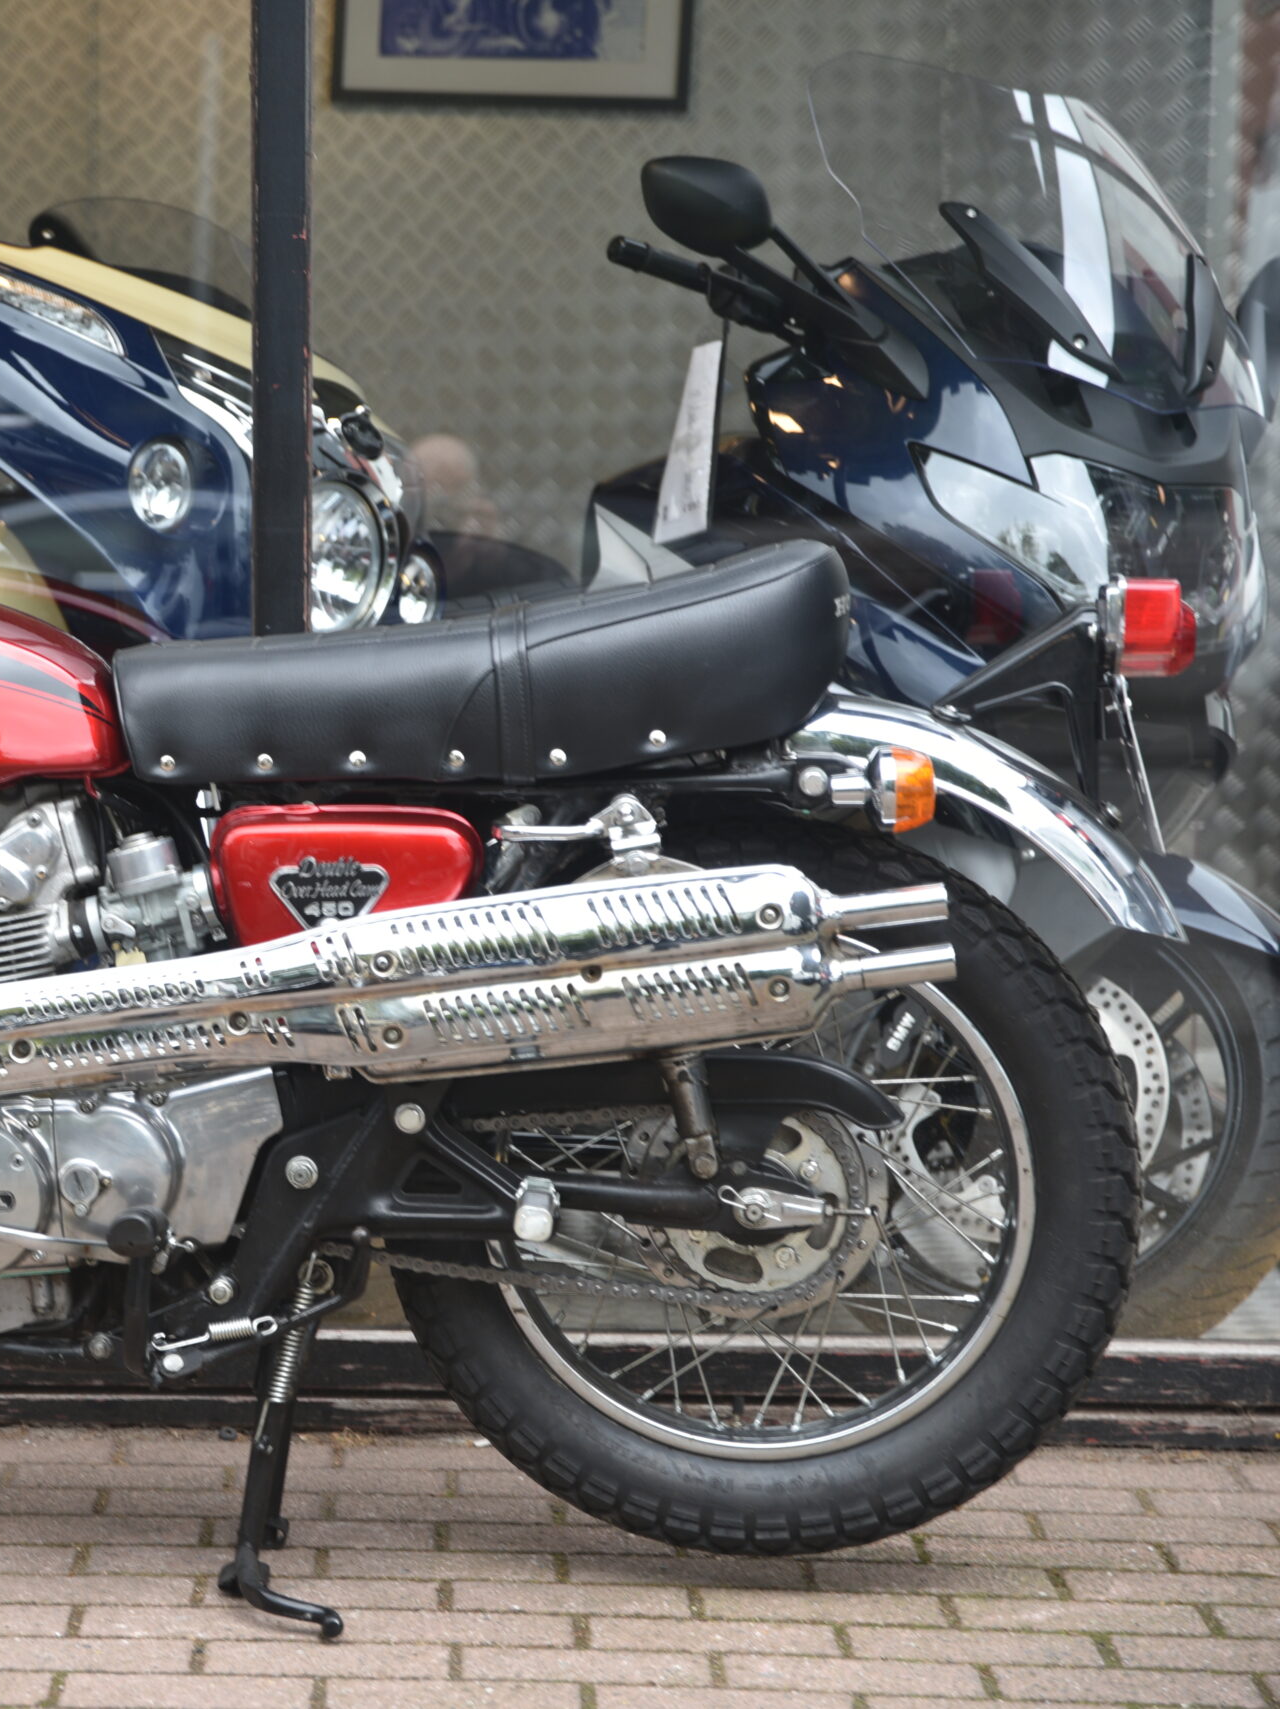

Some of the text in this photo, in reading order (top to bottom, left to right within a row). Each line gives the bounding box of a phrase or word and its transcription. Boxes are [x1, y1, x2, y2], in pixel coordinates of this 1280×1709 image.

[298, 855, 362, 878] Double
[280, 879, 382, 899] Over Head Cam
[303, 901, 355, 918] 450
[886, 1011, 916, 1053] BMW
